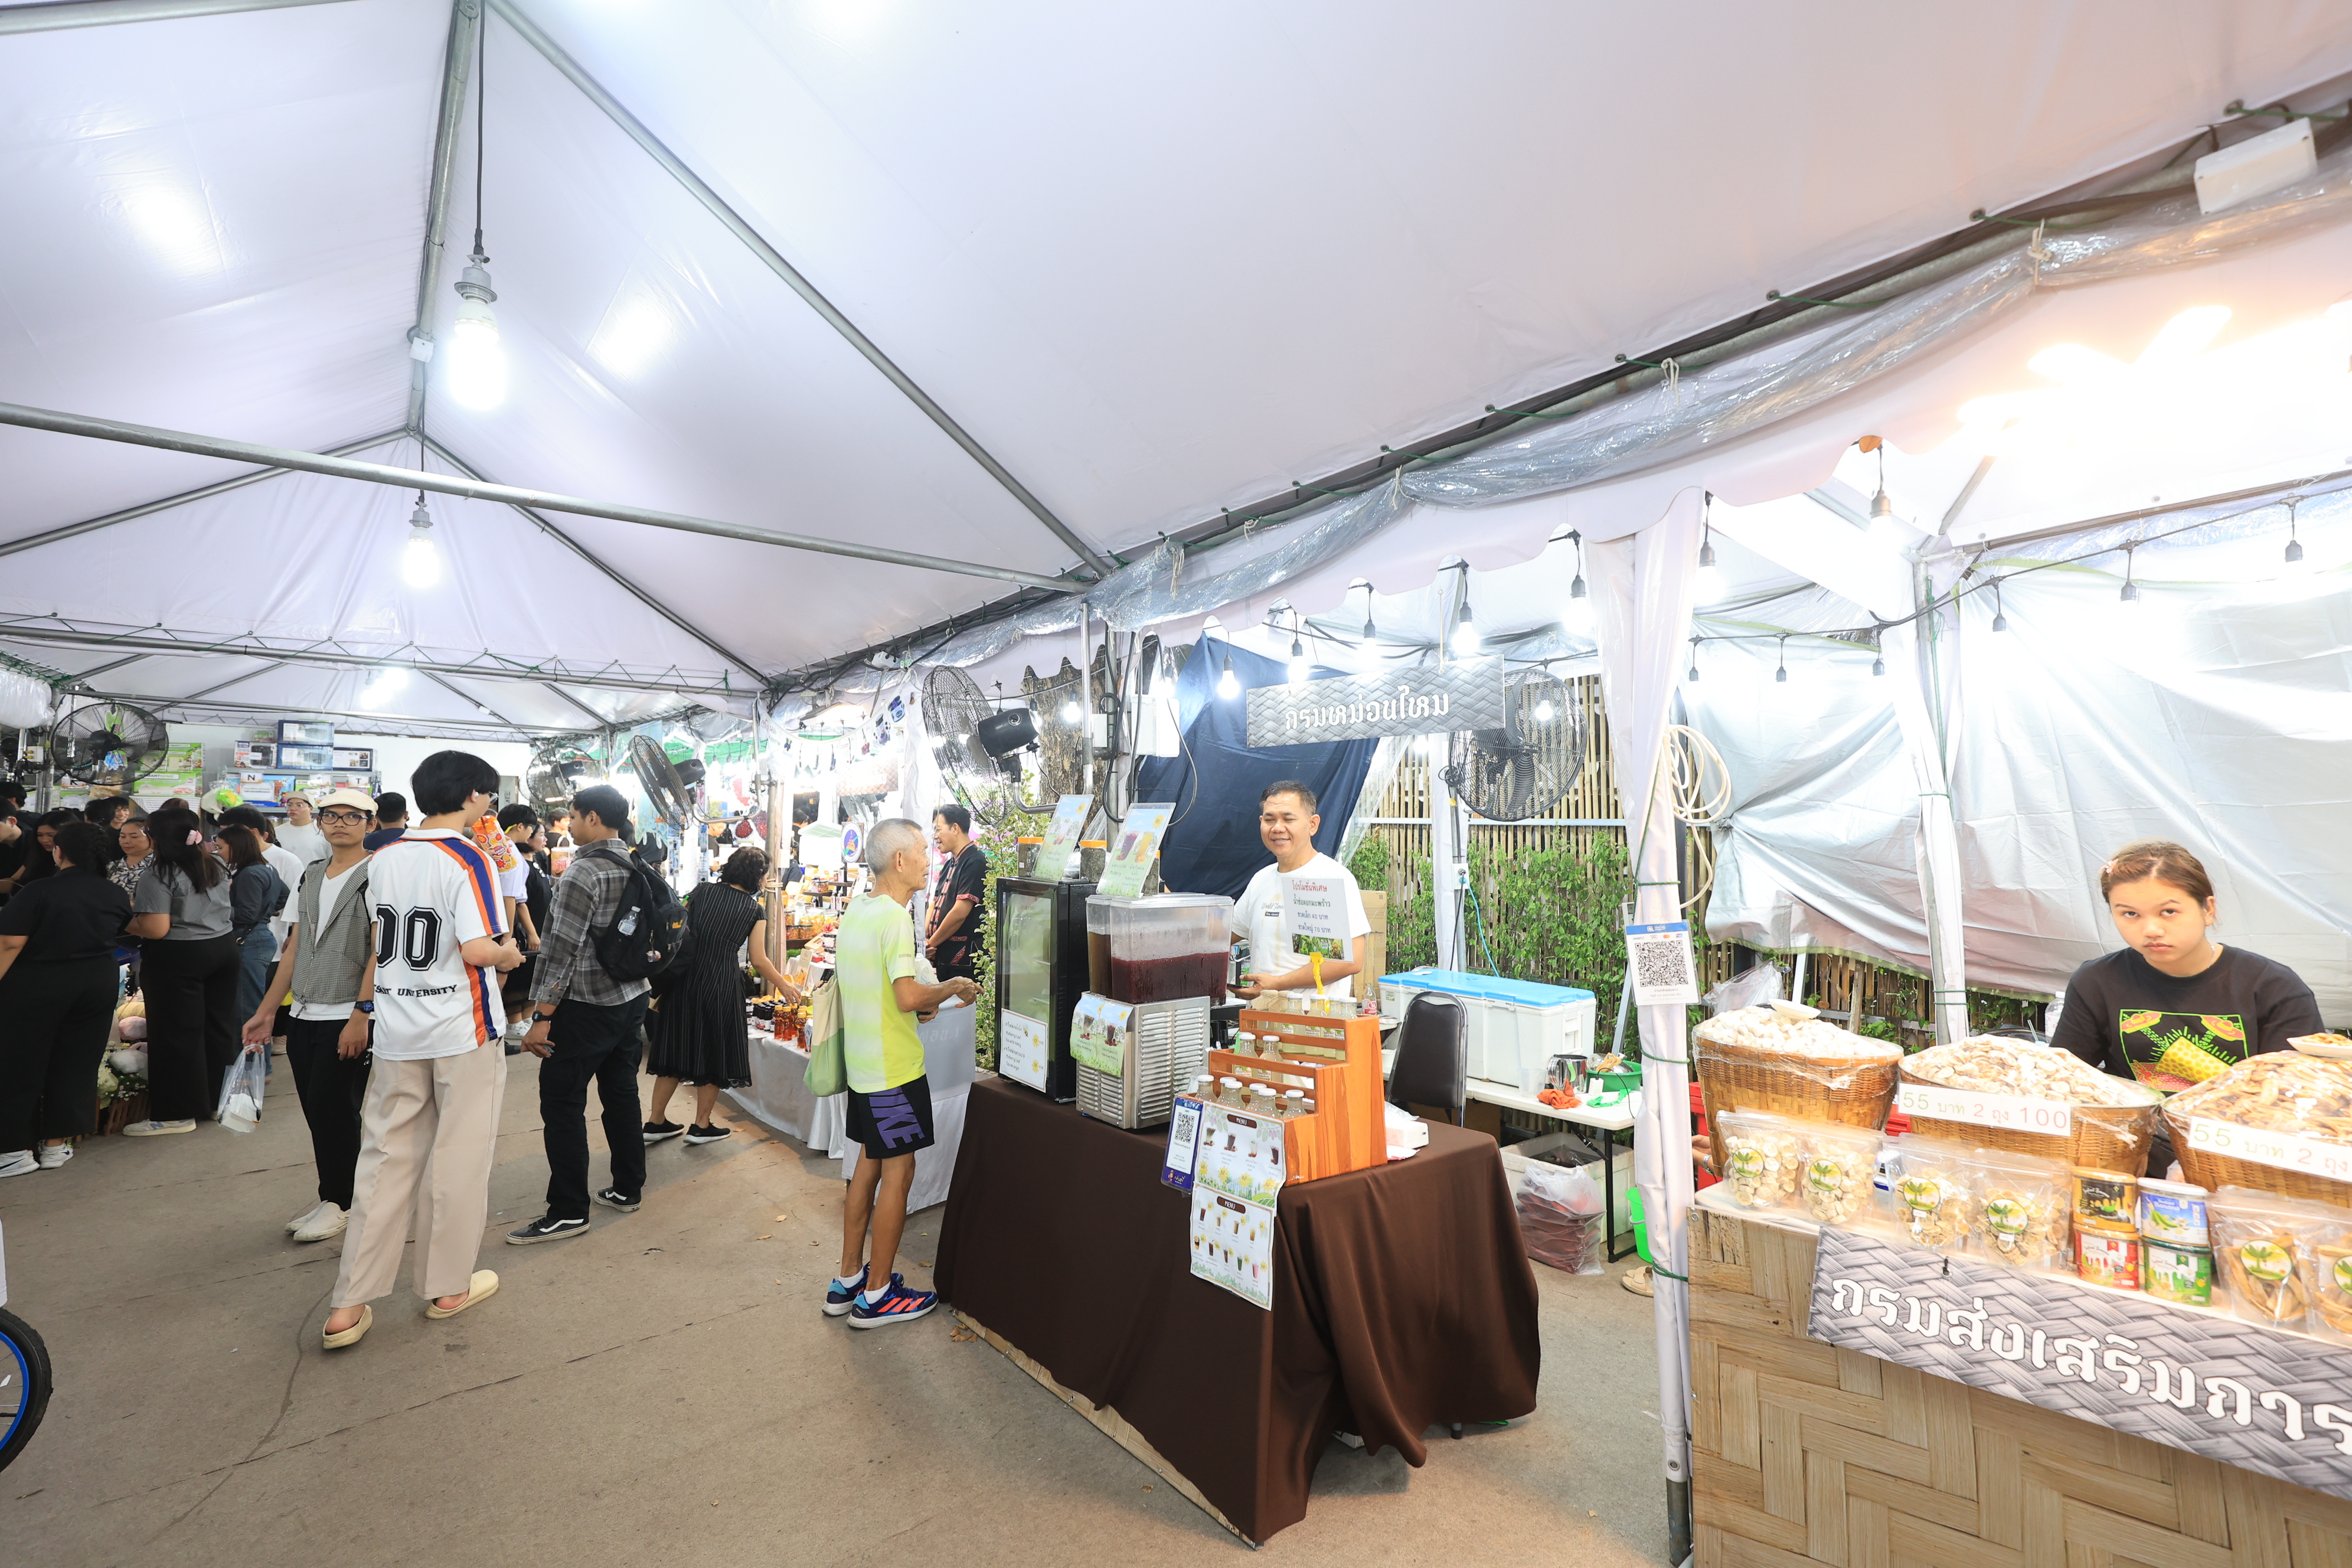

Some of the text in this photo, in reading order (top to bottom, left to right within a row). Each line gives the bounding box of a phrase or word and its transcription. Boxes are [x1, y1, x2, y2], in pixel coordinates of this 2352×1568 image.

[1285, 685, 1449, 730] กรมหม่อนไหม
[1292, 880, 1327, 892] โปรโมชั่นพิเศษ
[1293, 894, 1331, 907] น้ำช่อดอกมะพร้าว
[1298, 910, 1311, 919] ขวดเล็ก
[1298, 923, 1314, 933] ขวดใหญ่
[1901, 1092, 2068, 1128] 55 บาท 2 ถุง 100
[868, 1085, 925, 1149] IKE
[1236, 1117, 1247, 1125] MENU
[2194, 1124, 2348, 1175] 55 บาท 2 ถุง
[1224, 1200, 1236, 1210] MENU
